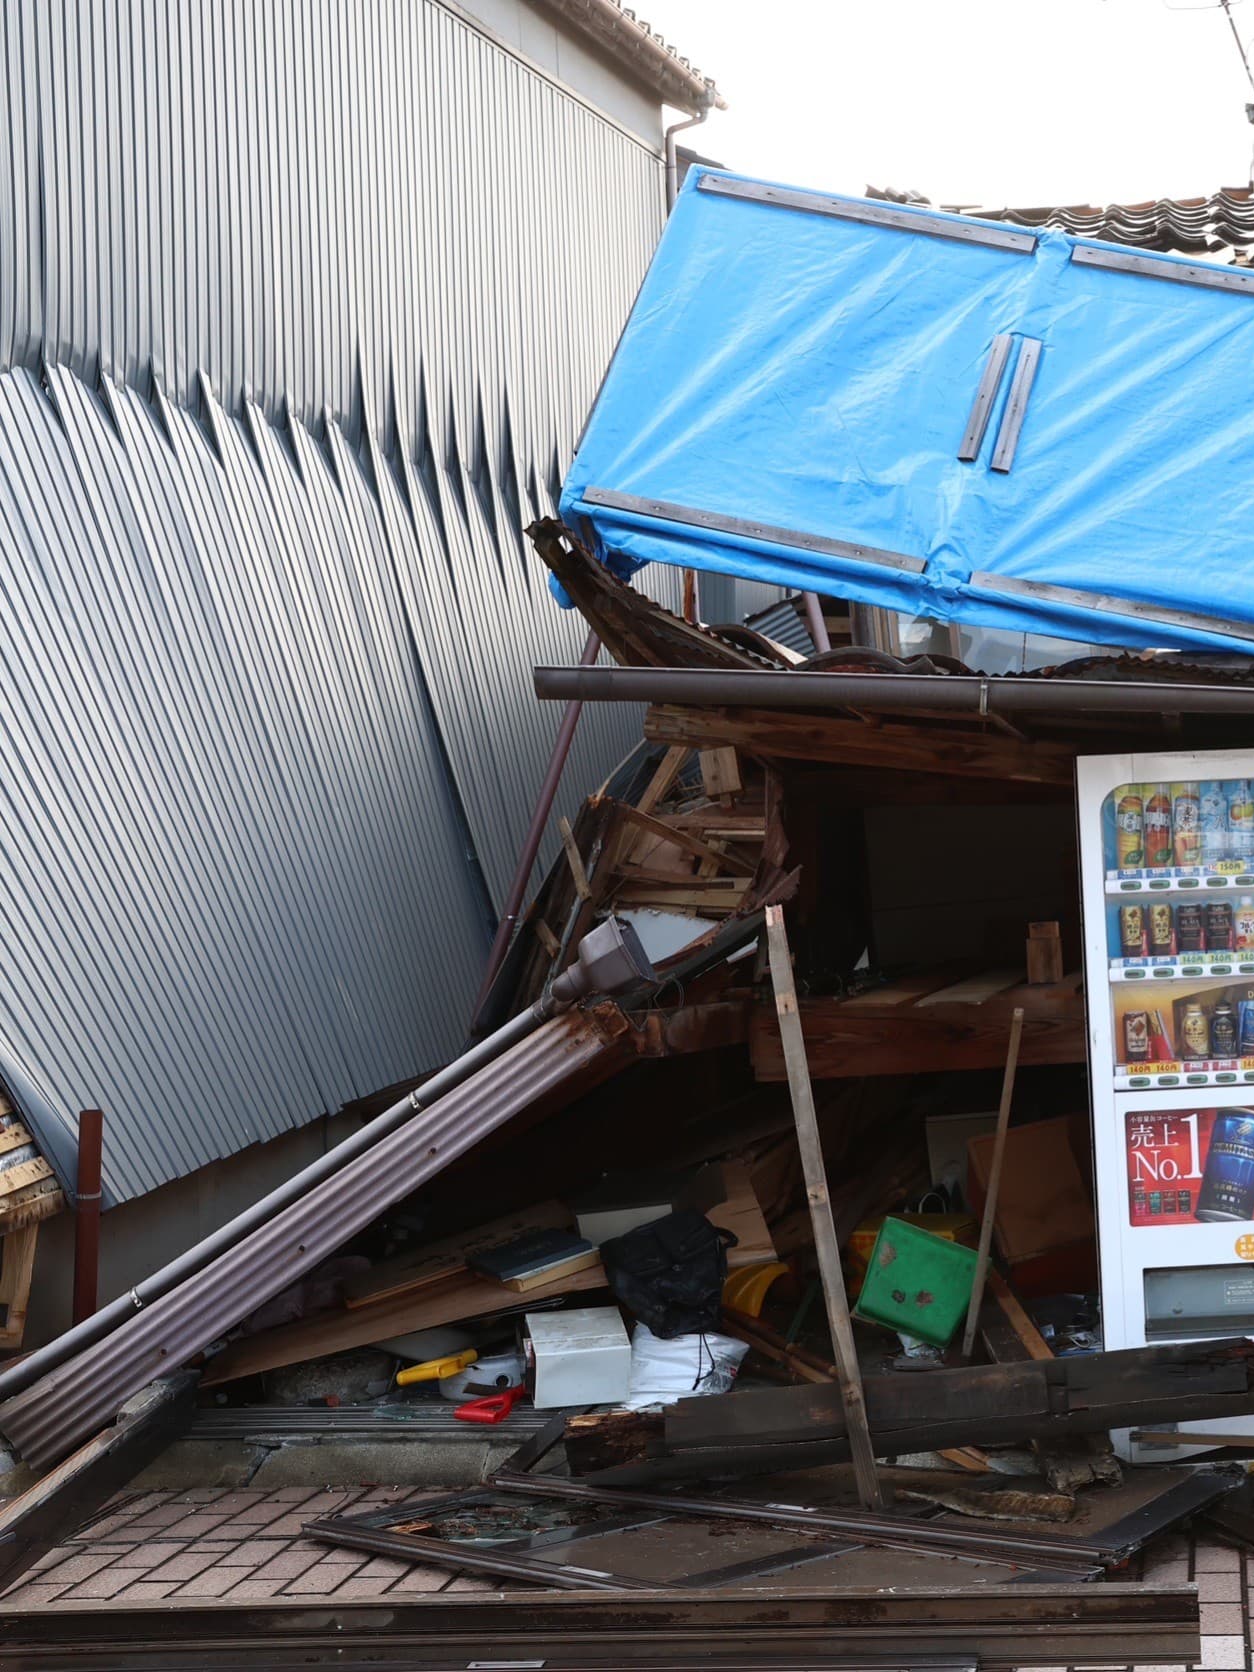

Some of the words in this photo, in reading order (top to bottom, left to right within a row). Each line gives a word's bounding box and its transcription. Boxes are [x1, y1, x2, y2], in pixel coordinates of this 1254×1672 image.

[1219, 861, 1241, 871] 150円
[1130, 1065, 1151, 1073] 140円
[1156, 1064, 1177, 1072] 140円
[1130, 1123, 1179, 1149] 売上
